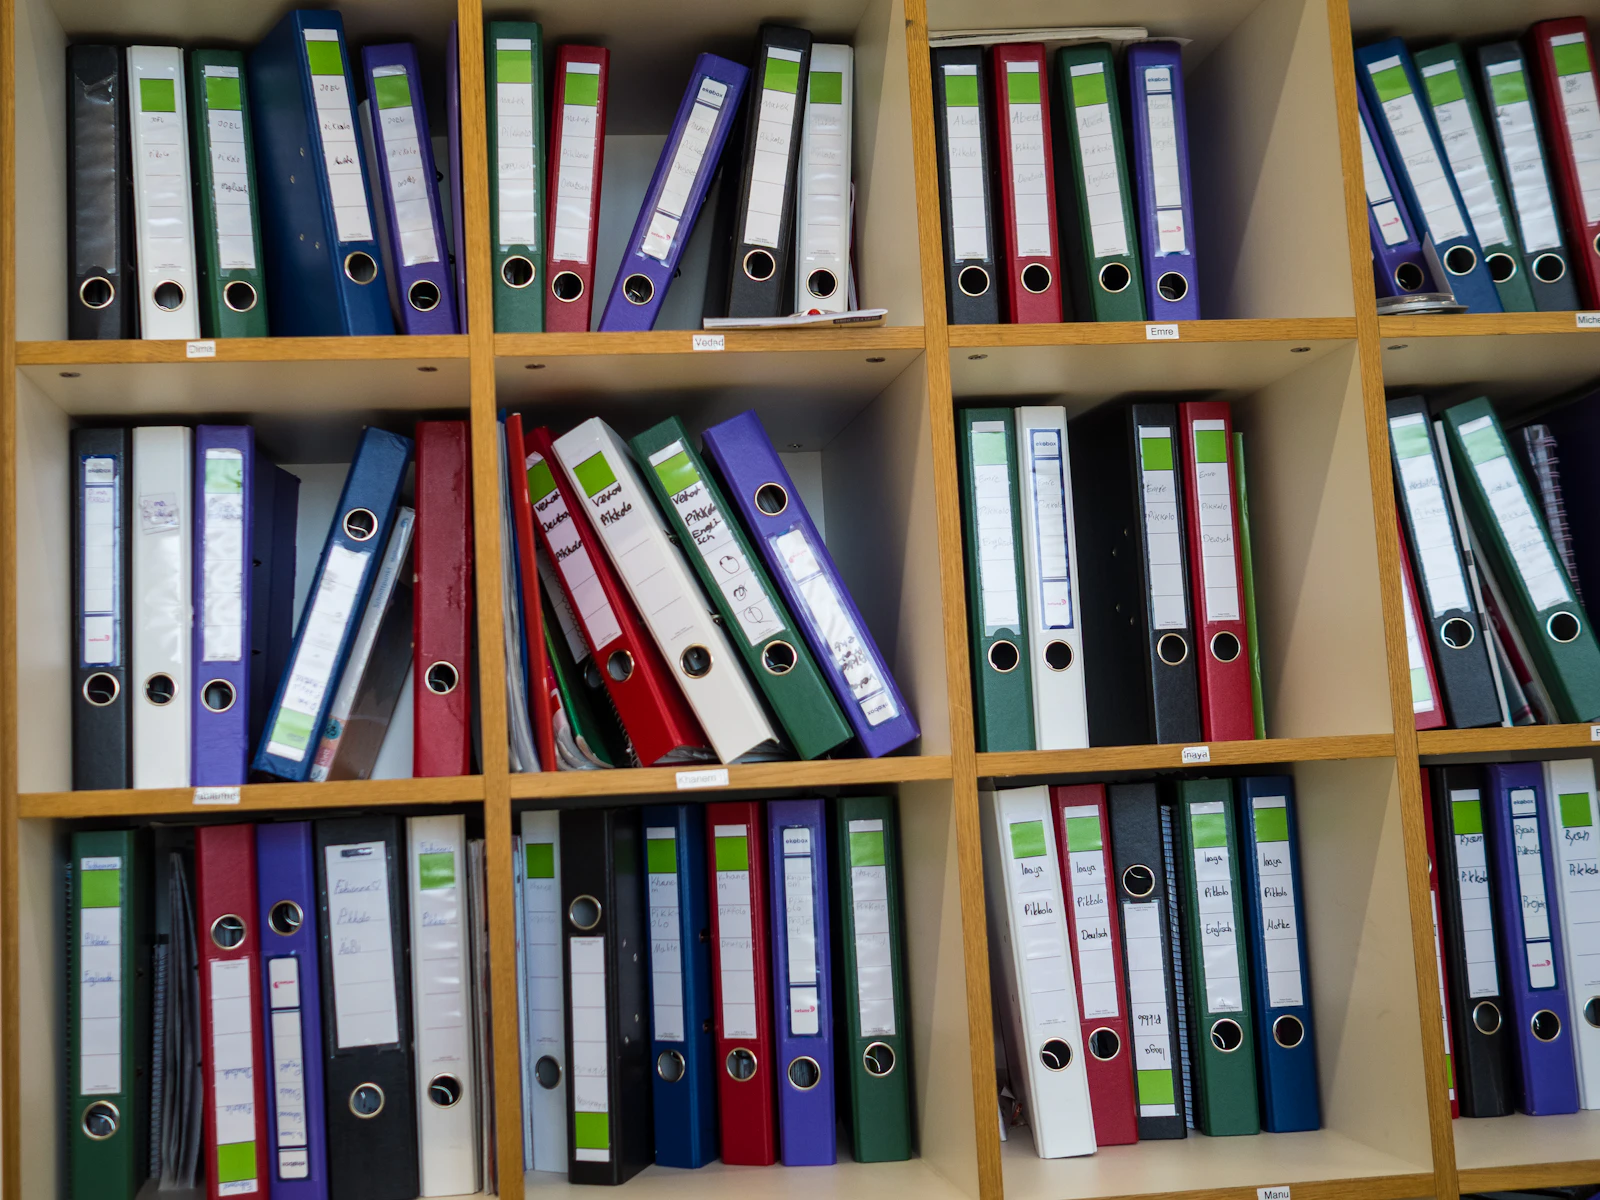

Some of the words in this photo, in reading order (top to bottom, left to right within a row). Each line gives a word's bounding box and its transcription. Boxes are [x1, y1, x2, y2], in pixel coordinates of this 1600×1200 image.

[1151, 327, 1174, 336] Emre
[599, 501, 632, 527] Pikkolo
[1564, 829, 1590, 846] Ryan
[1263, 853, 1283, 867] Inaya
[1021, 862, 1044, 878] Inaya
[1076, 862, 1097, 875] Inaya
[1077, 894, 1104, 908] Pikkolo
[1024, 901, 1053, 916] Pikkolo
[1081, 928, 1108, 940] Deutsch
[1205, 921, 1232, 937] Englisch
[1264, 1191, 1289, 1200] Manu
